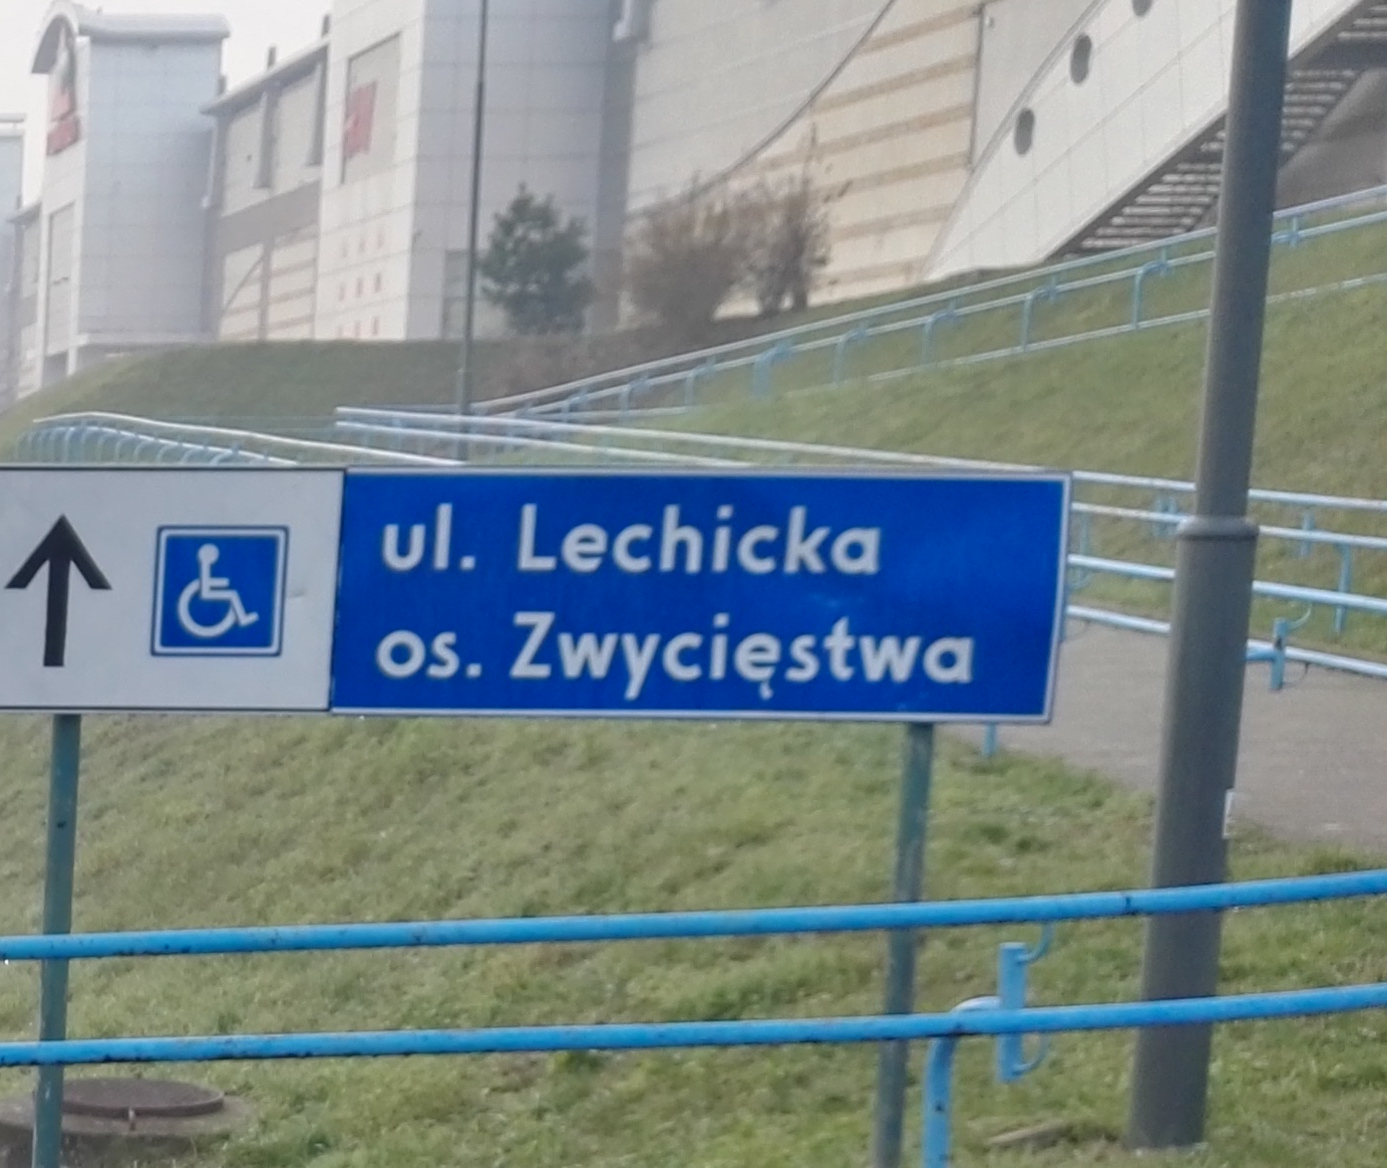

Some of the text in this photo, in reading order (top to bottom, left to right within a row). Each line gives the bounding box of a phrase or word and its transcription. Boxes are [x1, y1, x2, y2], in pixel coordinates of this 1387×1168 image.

[383, 503, 880, 574] ul. Lechicka
[377, 612, 973, 699] os. Zwycięstwa
